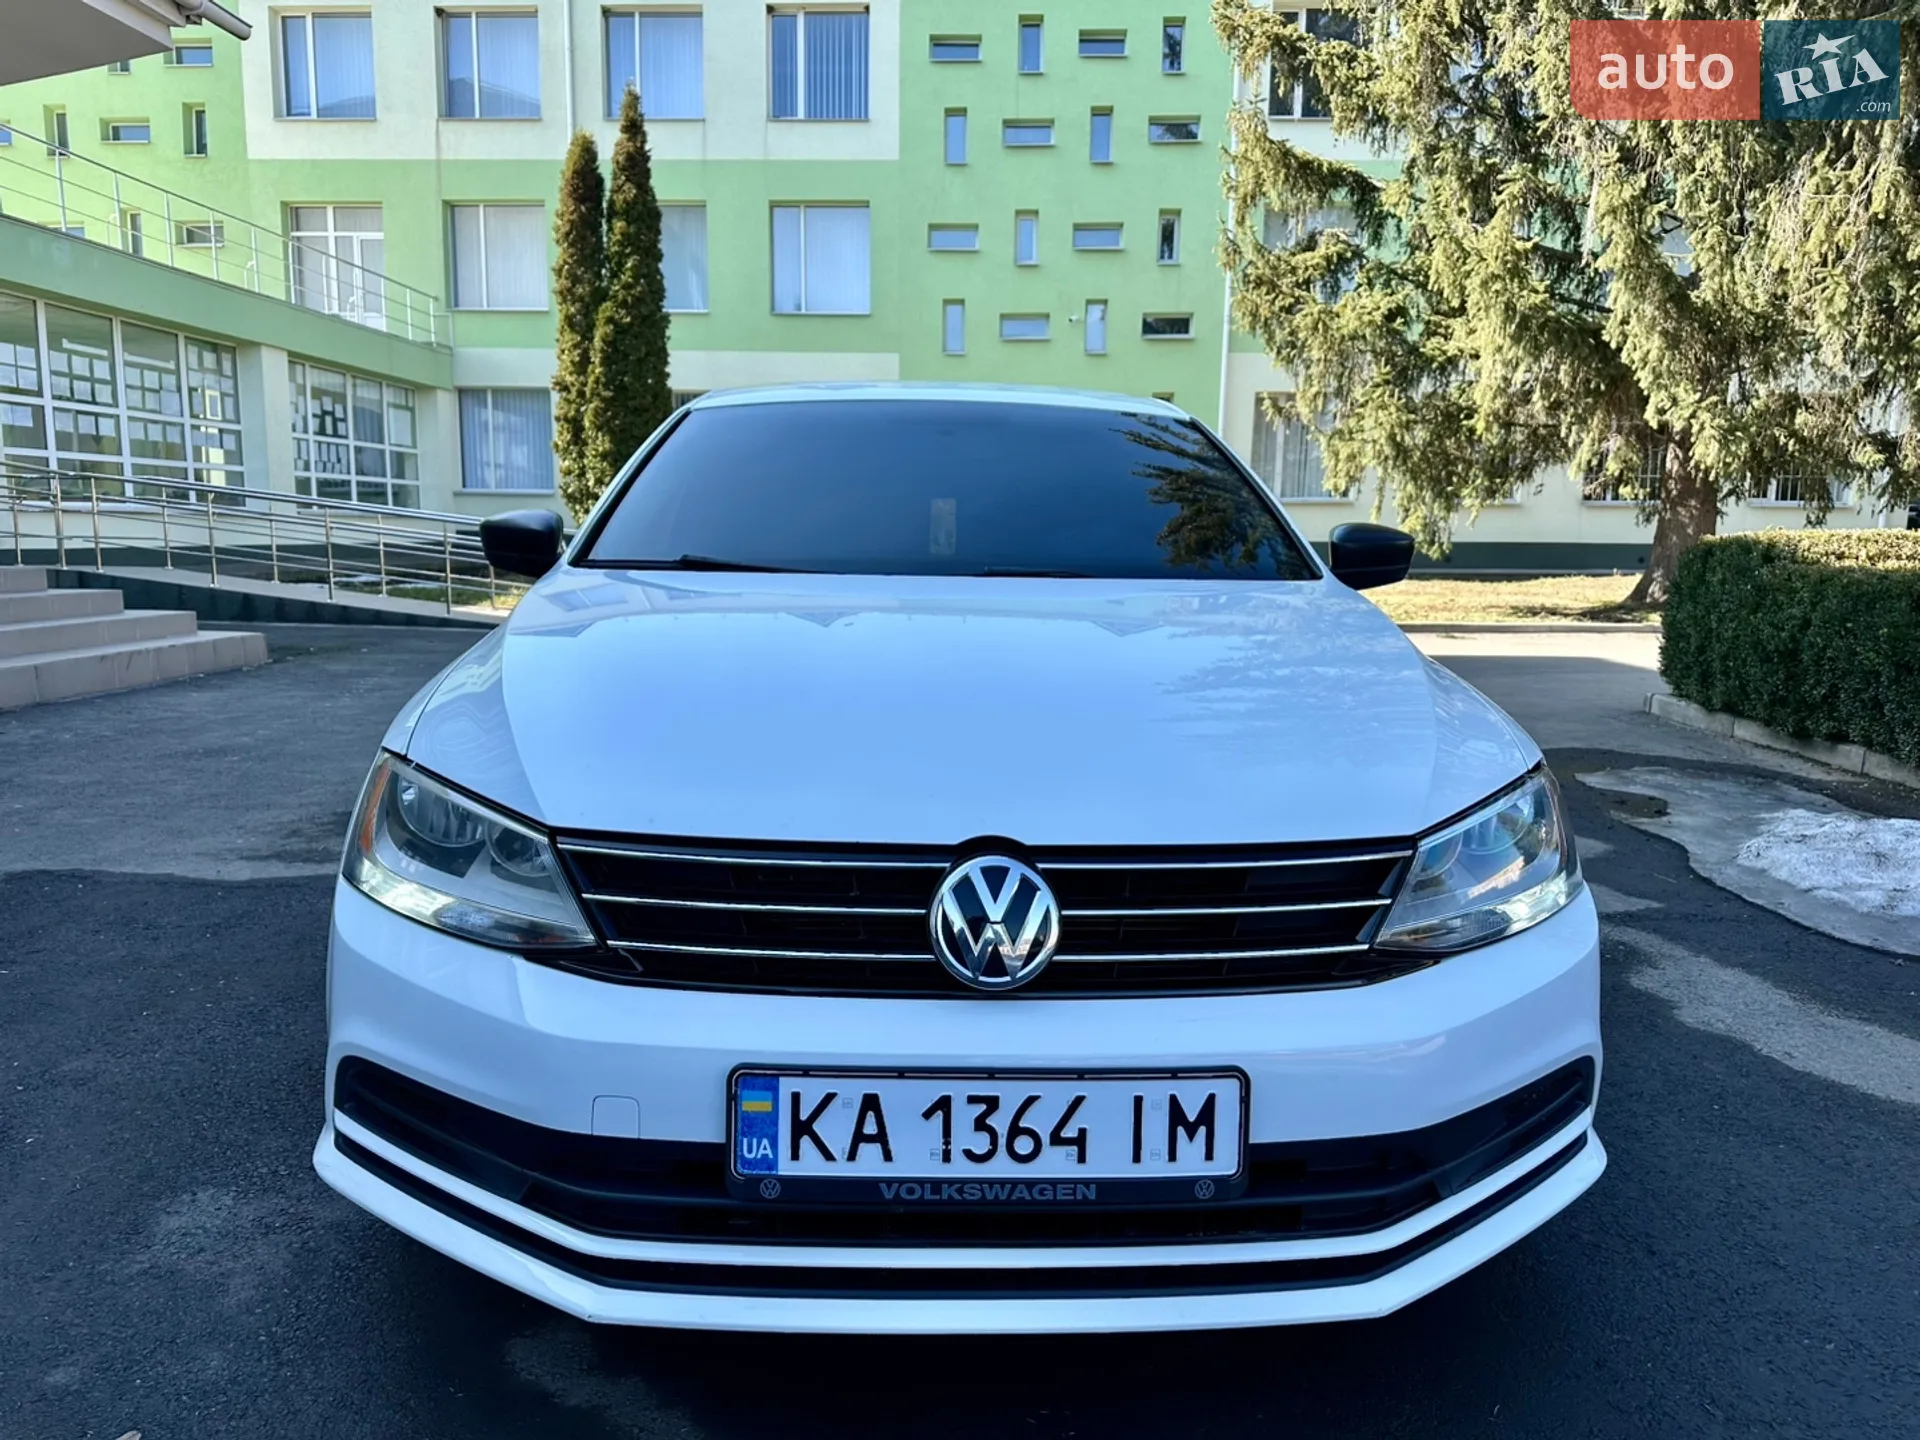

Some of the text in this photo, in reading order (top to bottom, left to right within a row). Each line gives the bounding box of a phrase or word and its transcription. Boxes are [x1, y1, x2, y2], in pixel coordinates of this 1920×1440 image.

[790, 1091, 1216, 1163] KA 1364 IM
[743, 1138, 773, 1159] UA
[879, 1183, 1096, 1200] VOLKSWAGEN
